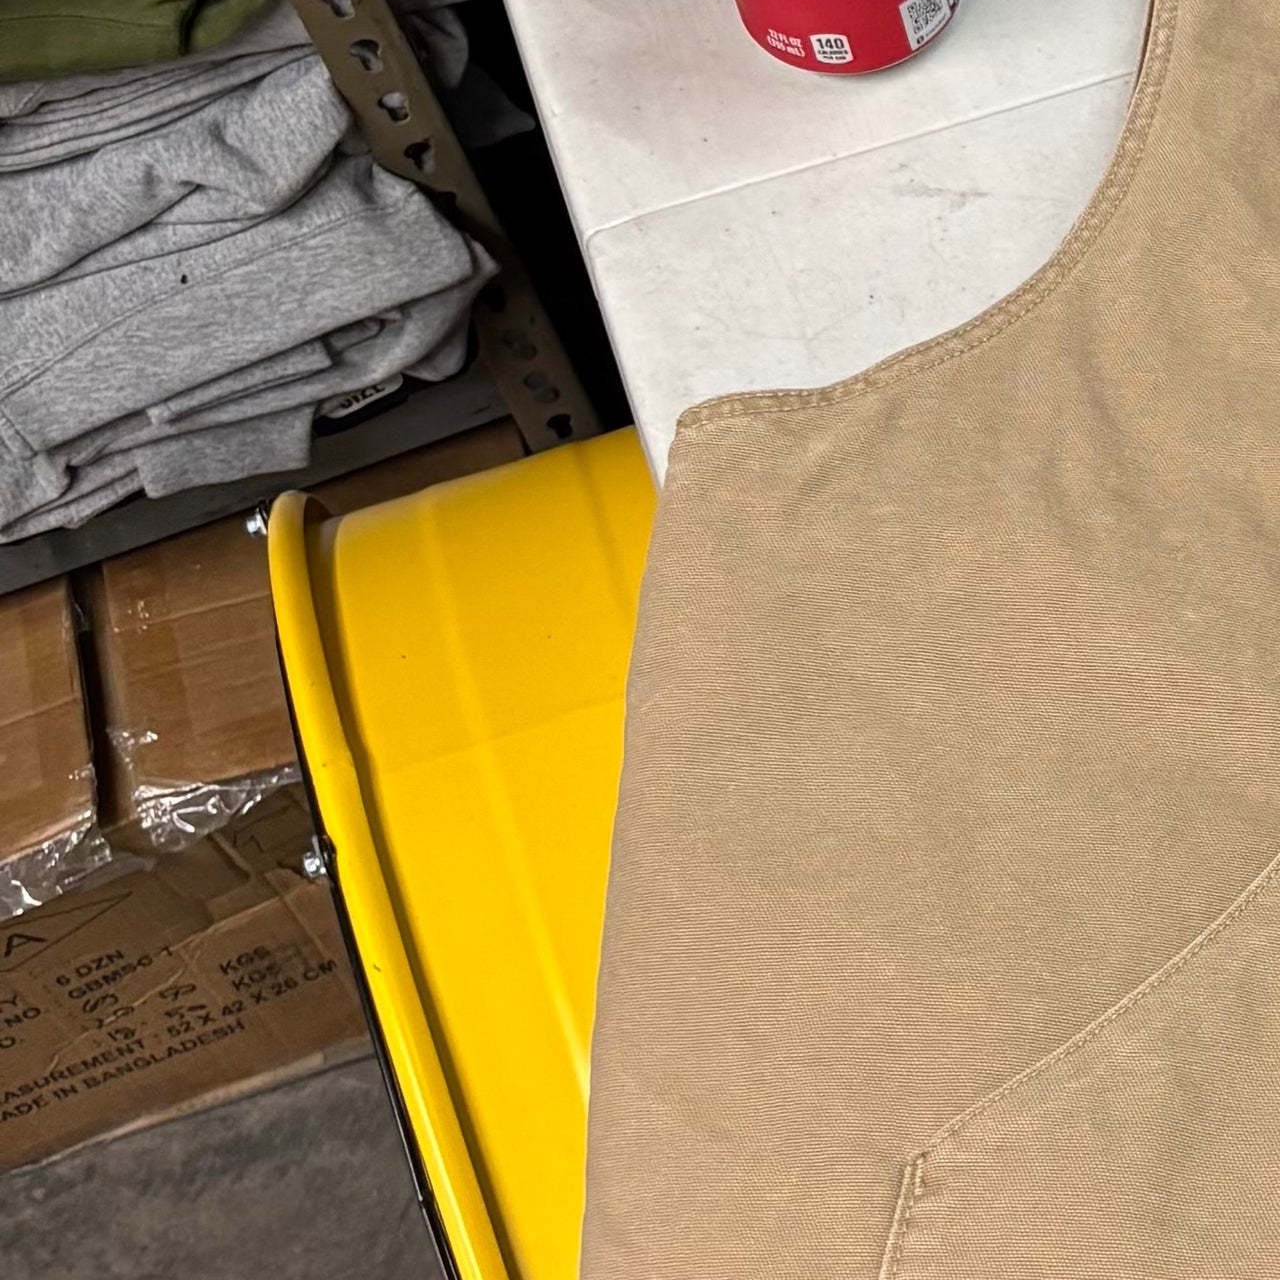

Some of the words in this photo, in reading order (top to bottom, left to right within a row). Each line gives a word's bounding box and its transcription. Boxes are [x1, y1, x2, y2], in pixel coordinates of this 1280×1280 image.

[816, 38, 844, 49] 140
[75, 950, 125, 977] DZN
[198, 1012, 216, 1026] X
[250, 990, 268, 1005] X
[303, 959, 337, 982] CM
[54, 1084, 79, 1100] IN
[84, 1017, 246, 1090] BANGLADESH
